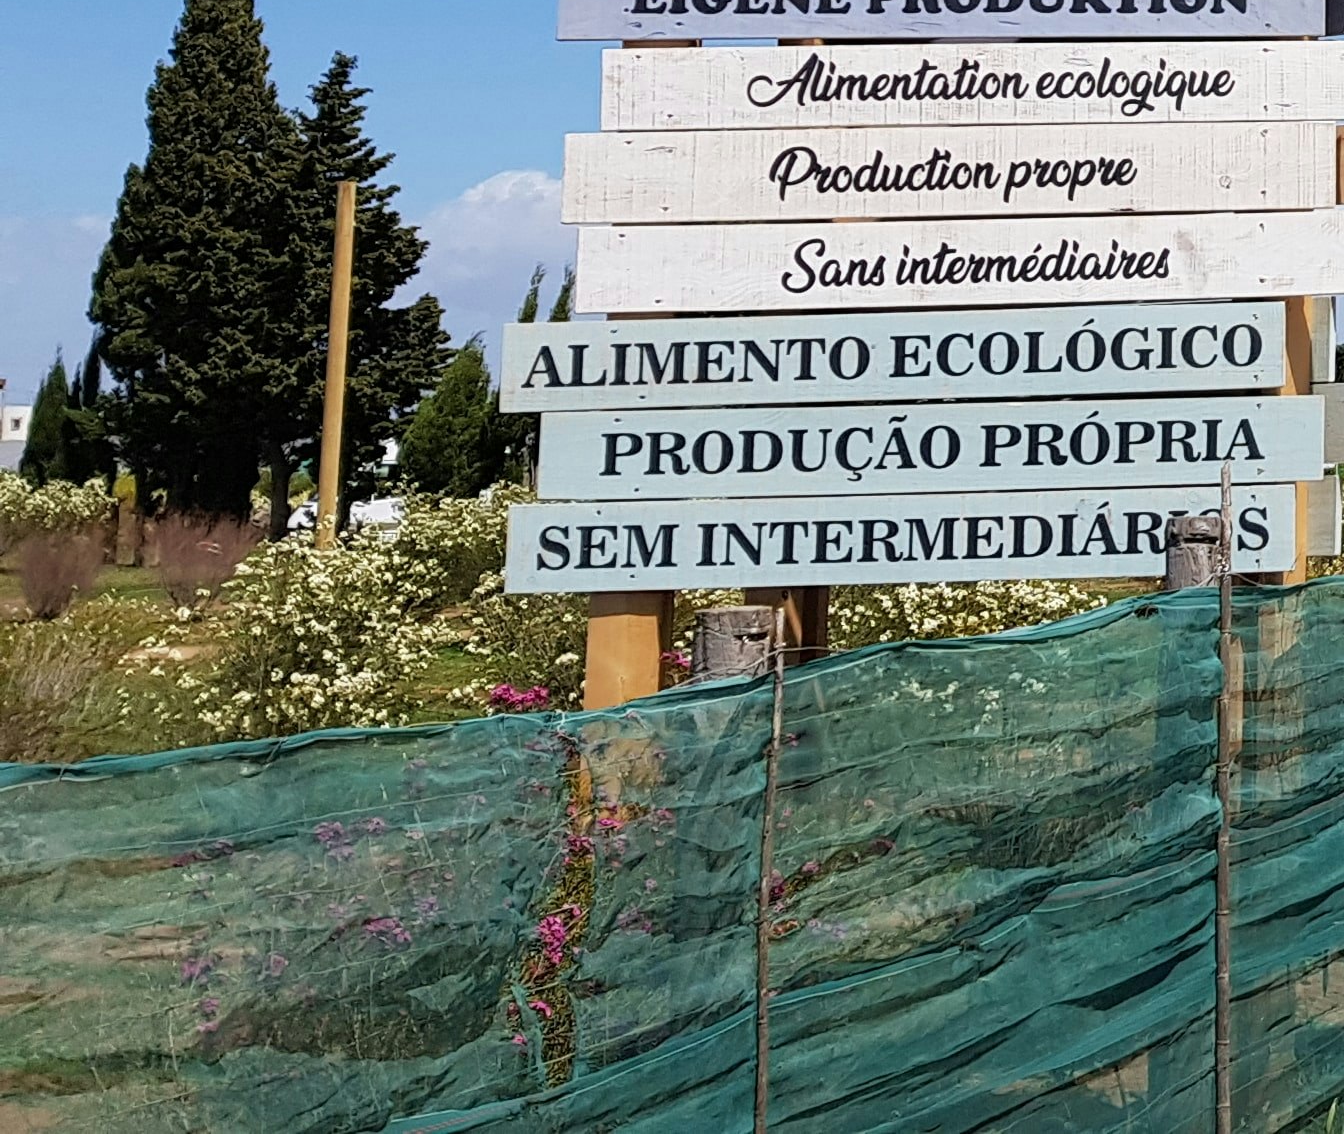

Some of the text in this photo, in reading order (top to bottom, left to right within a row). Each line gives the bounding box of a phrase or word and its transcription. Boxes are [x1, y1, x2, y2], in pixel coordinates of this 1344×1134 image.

[747, 52, 1235, 115] Alimentation ecologique
[769, 146, 1138, 203] Production propre
[781, 238, 1170, 294] Sans intermédiaires
[520, 323, 1263, 389] ALIMENTO ECOLÓGICO
[599, 410, 1265, 482] PRODUÇÃO PRÓPRIA
[536, 501, 1270, 571] SEM INTERMEDIÁRS
